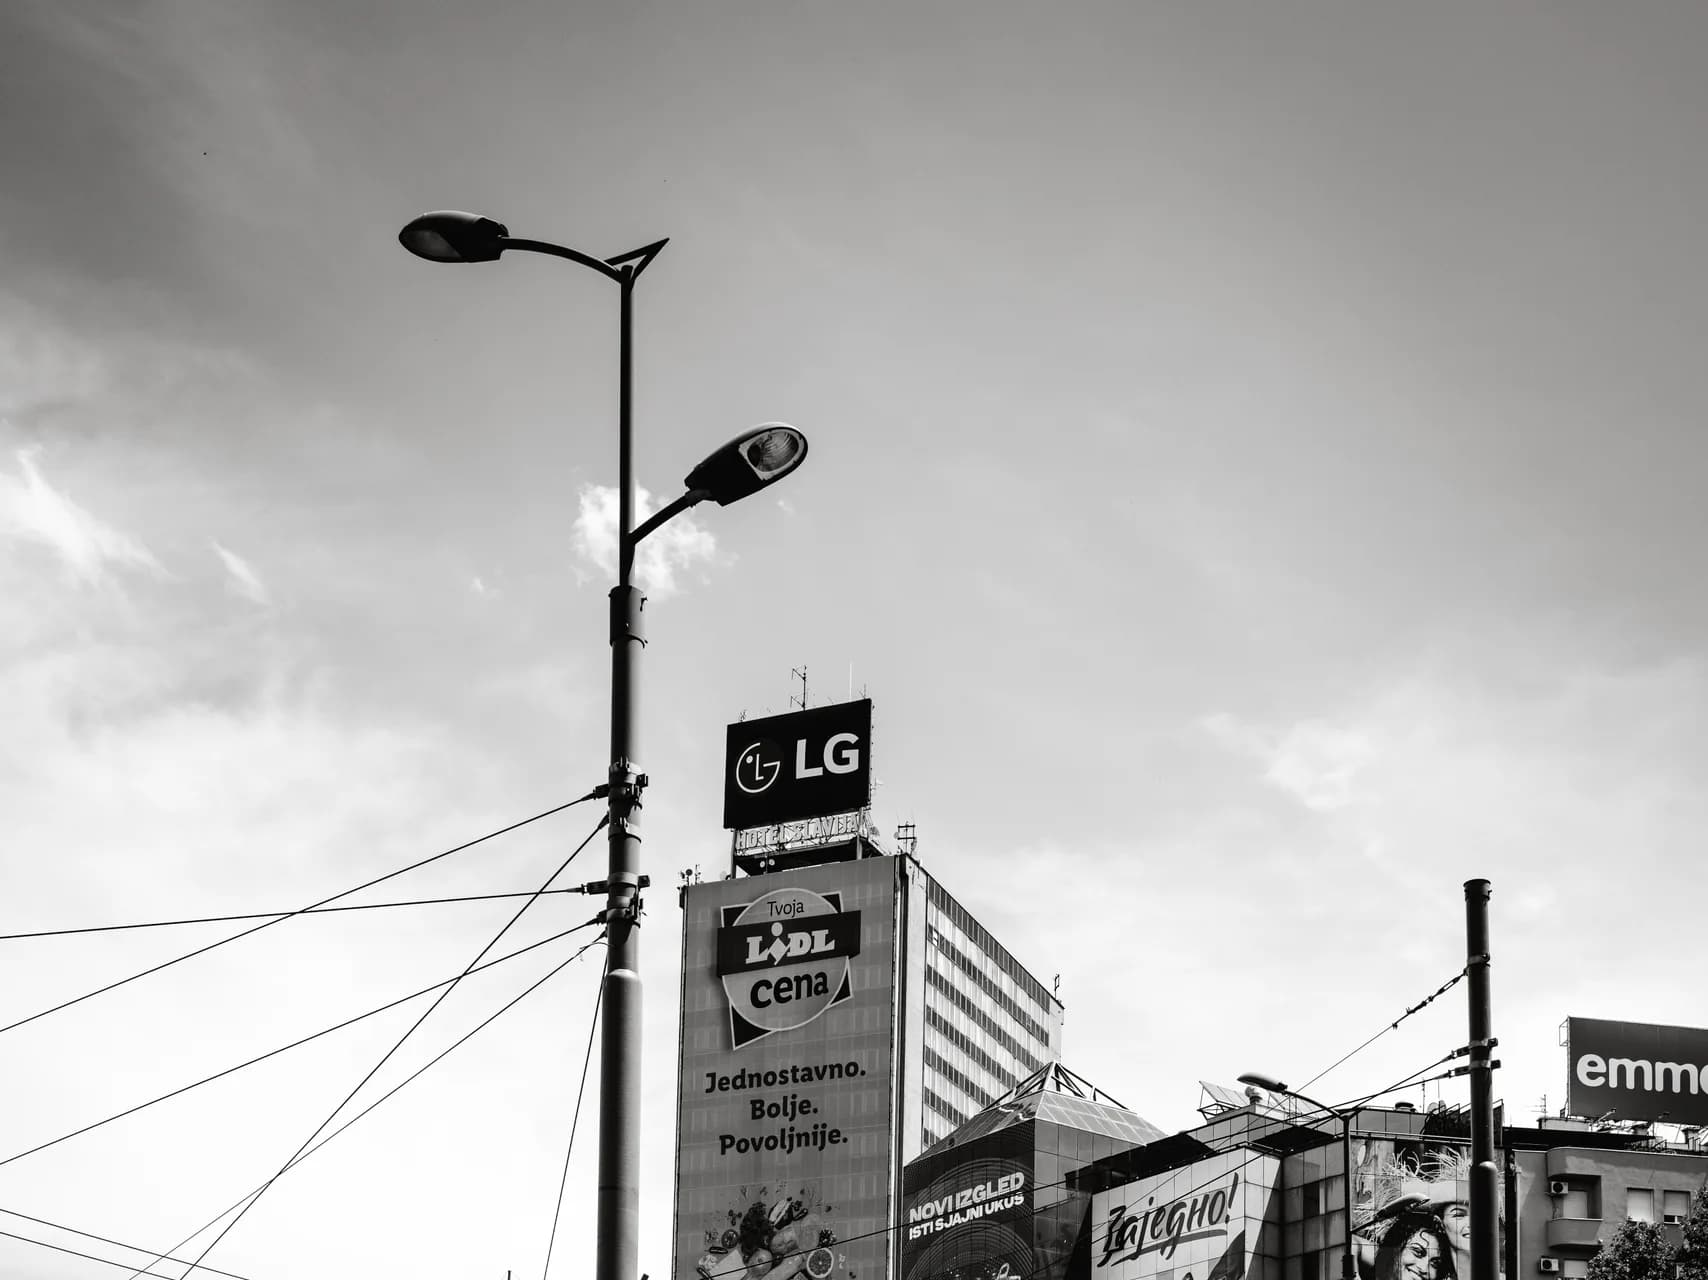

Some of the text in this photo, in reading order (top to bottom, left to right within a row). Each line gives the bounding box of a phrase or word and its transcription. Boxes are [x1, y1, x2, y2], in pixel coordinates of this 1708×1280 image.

[795, 733, 860, 780] LG
[736, 814, 859, 850] HOTEL SLAVIJA
[767, 899, 804, 918] Tvoja
[750, 972, 829, 1009] cena
[705, 1061, 867, 1093] Jednostavno.
[1576, 1053, 1708, 1095] emm
[750, 1094, 818, 1122] Bolje.
[719, 1123, 848, 1155] Povoljnije.
[909, 1172, 1025, 1223] NOVI IZGLED
[909, 1193, 1025, 1240] ISTI SJAJNI UKUS
